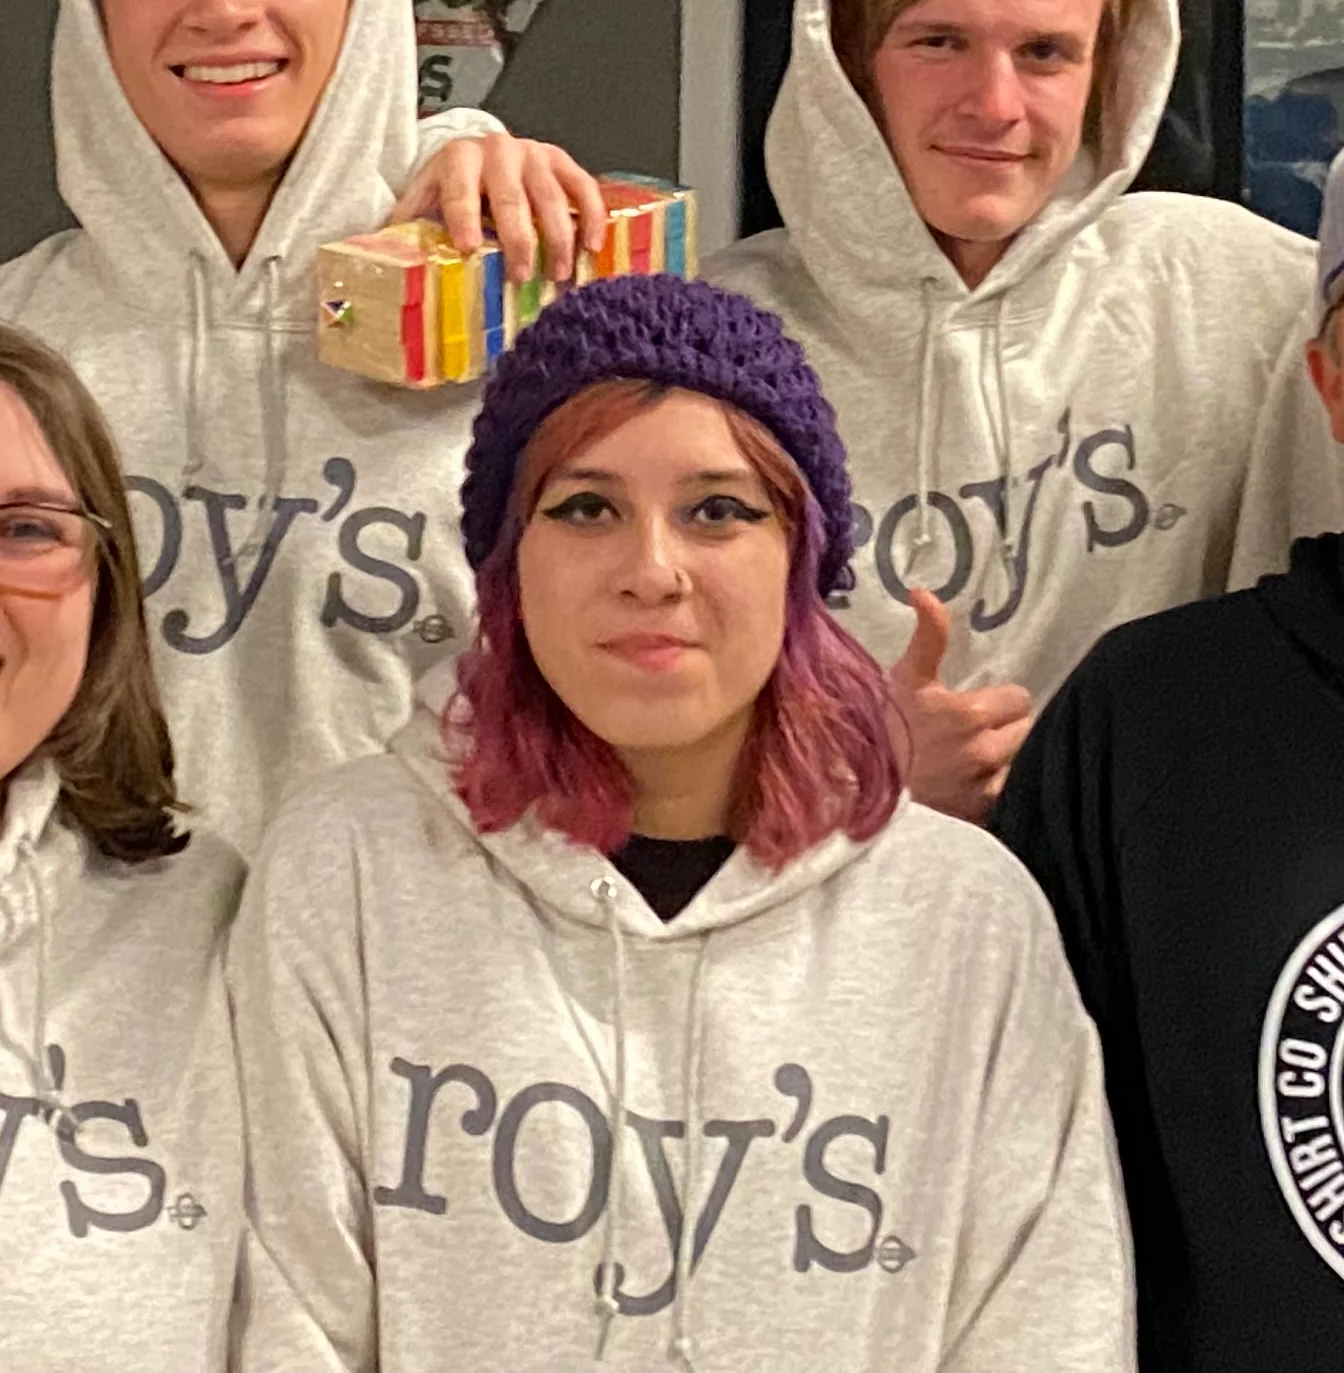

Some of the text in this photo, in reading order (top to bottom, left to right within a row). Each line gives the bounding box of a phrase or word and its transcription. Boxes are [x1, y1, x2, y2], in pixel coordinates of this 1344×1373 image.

[122, 457, 428, 655] oy's
[826, 405, 1149, 633] oy's
[1277, 1037, 1327, 1099] CO
[373, 1056, 891, 1317] roy's
